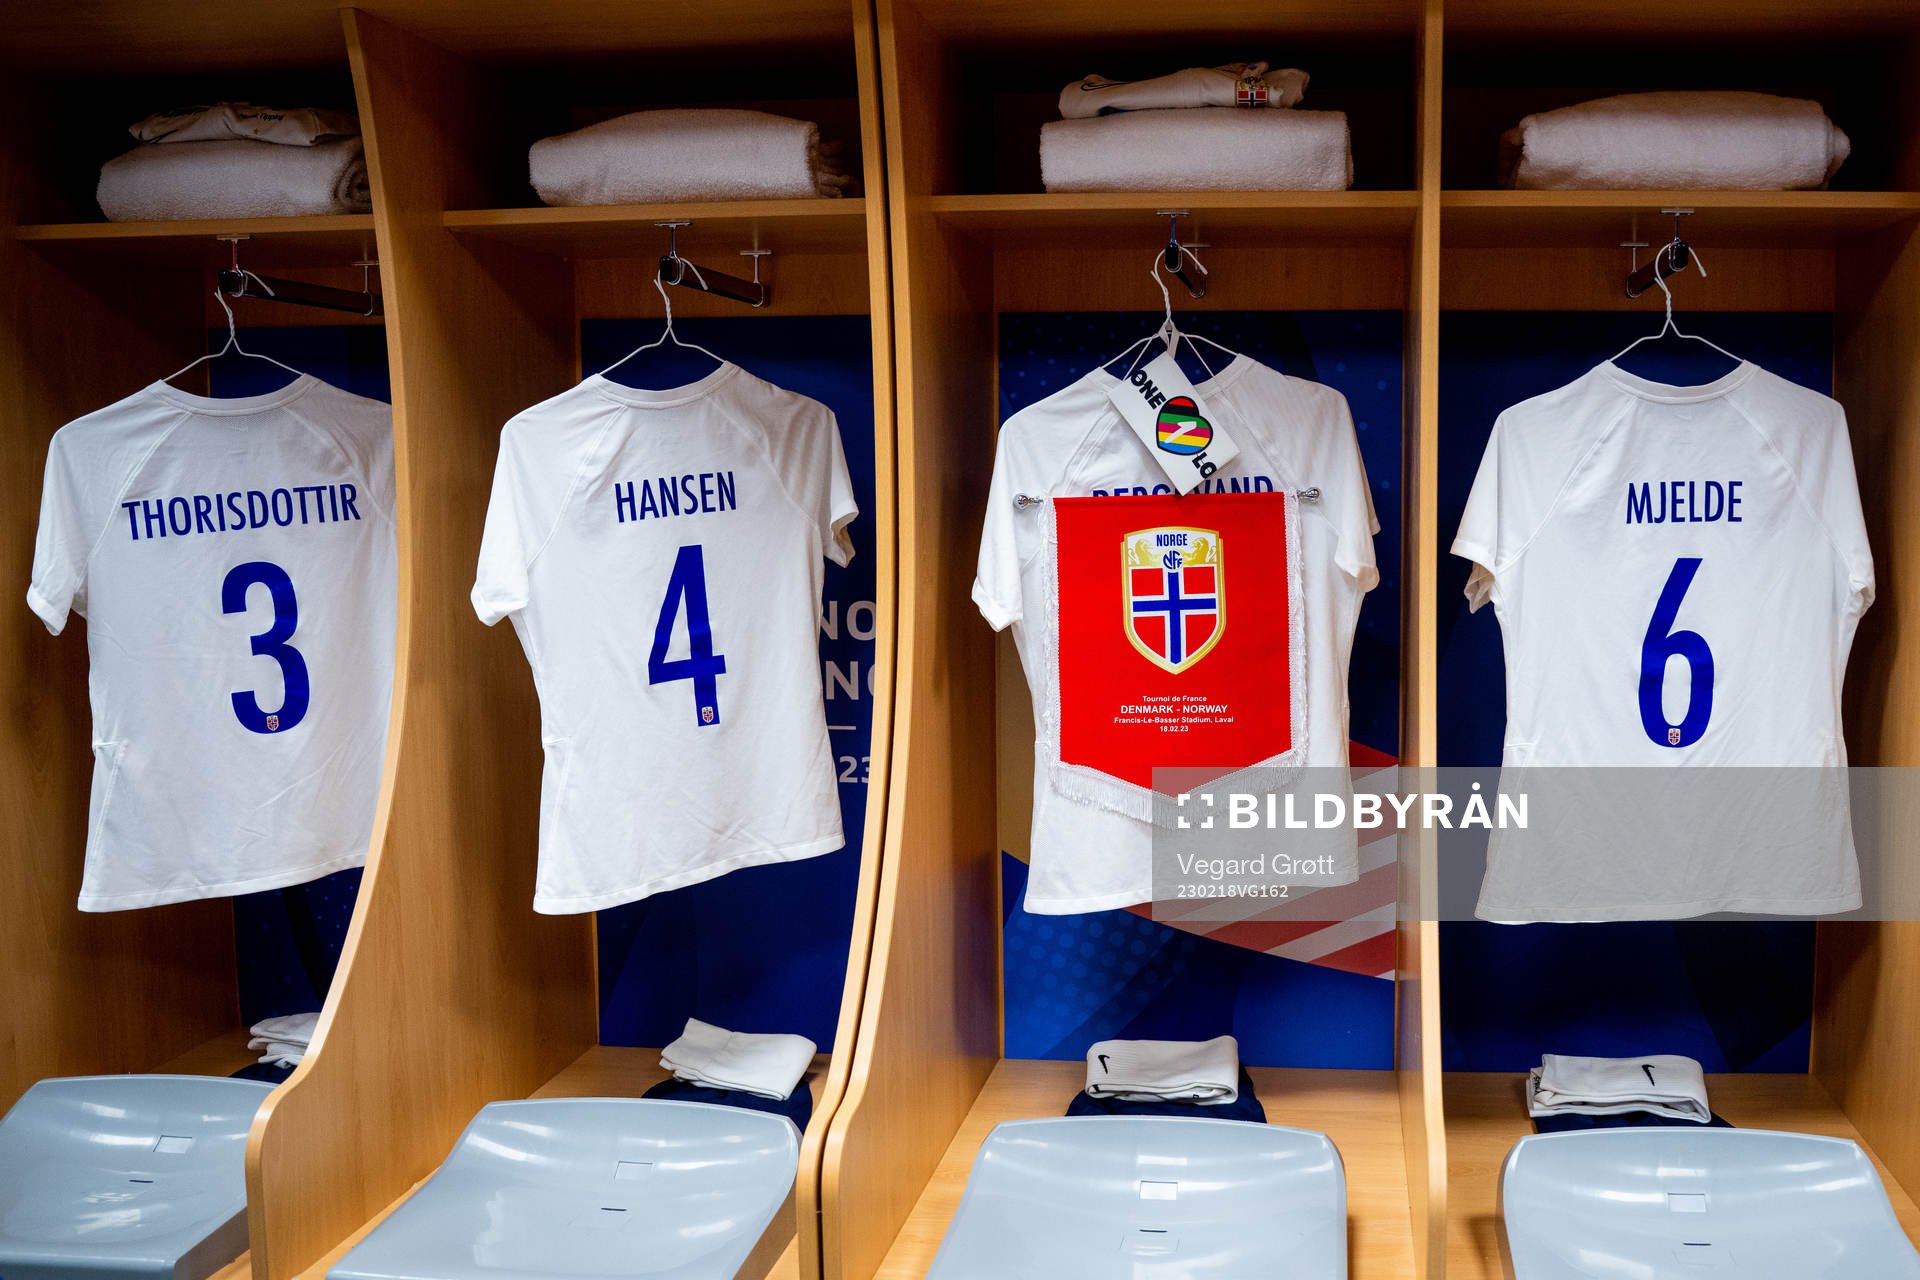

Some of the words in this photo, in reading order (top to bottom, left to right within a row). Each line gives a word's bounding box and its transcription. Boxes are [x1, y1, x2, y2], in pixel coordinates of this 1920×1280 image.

[1130, 369, 1167, 410] ONE
[121, 483, 361, 541] THORISDOTTIR
[614, 470, 737, 523] HANSEN
[1625, 480, 1743, 525] MJELDE
[1156, 533, 1188, 547] NORGE
[221, 561, 310, 734] 3
[648, 544, 727, 727] 4
[1638, 557, 1715, 749] 6
[1120, 705, 1174, 714] DENMARK
[1182, 705, 1228, 714] NORWAY
